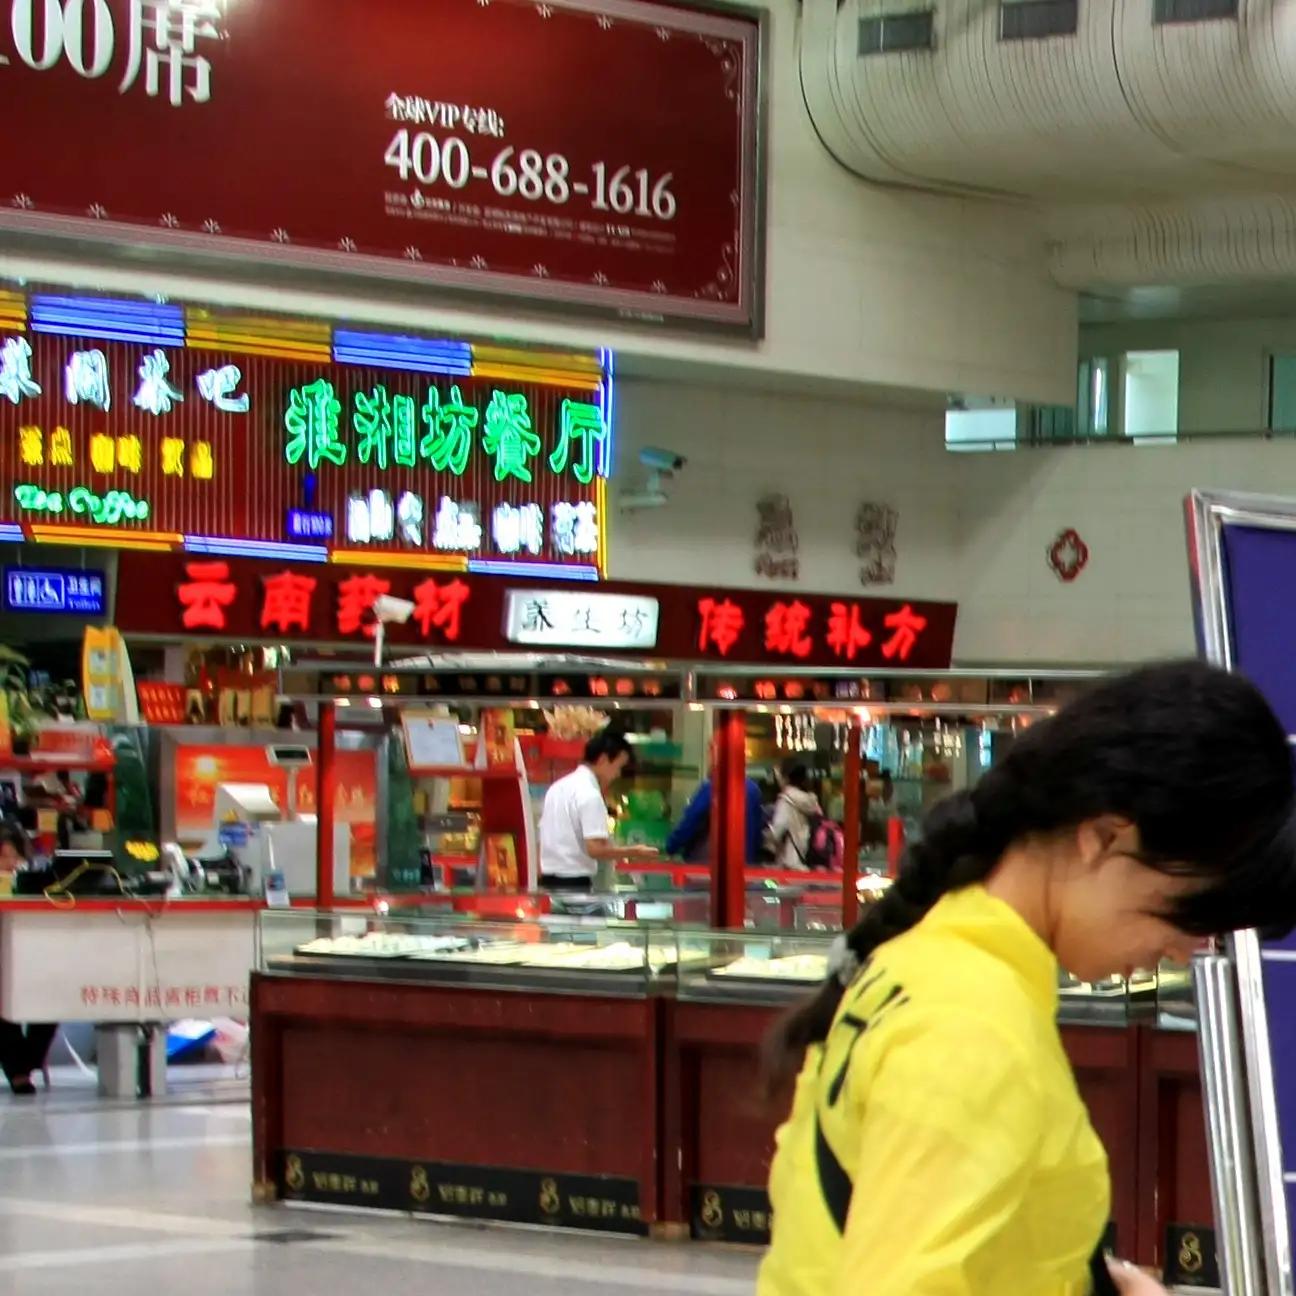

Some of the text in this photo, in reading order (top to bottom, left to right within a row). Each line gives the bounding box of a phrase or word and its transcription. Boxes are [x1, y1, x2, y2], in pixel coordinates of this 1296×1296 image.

[384, 128, 677, 220] 400-688-1616
[178, 562, 469, 640] 云南药材
[698, 597, 927, 661] 传统补方
